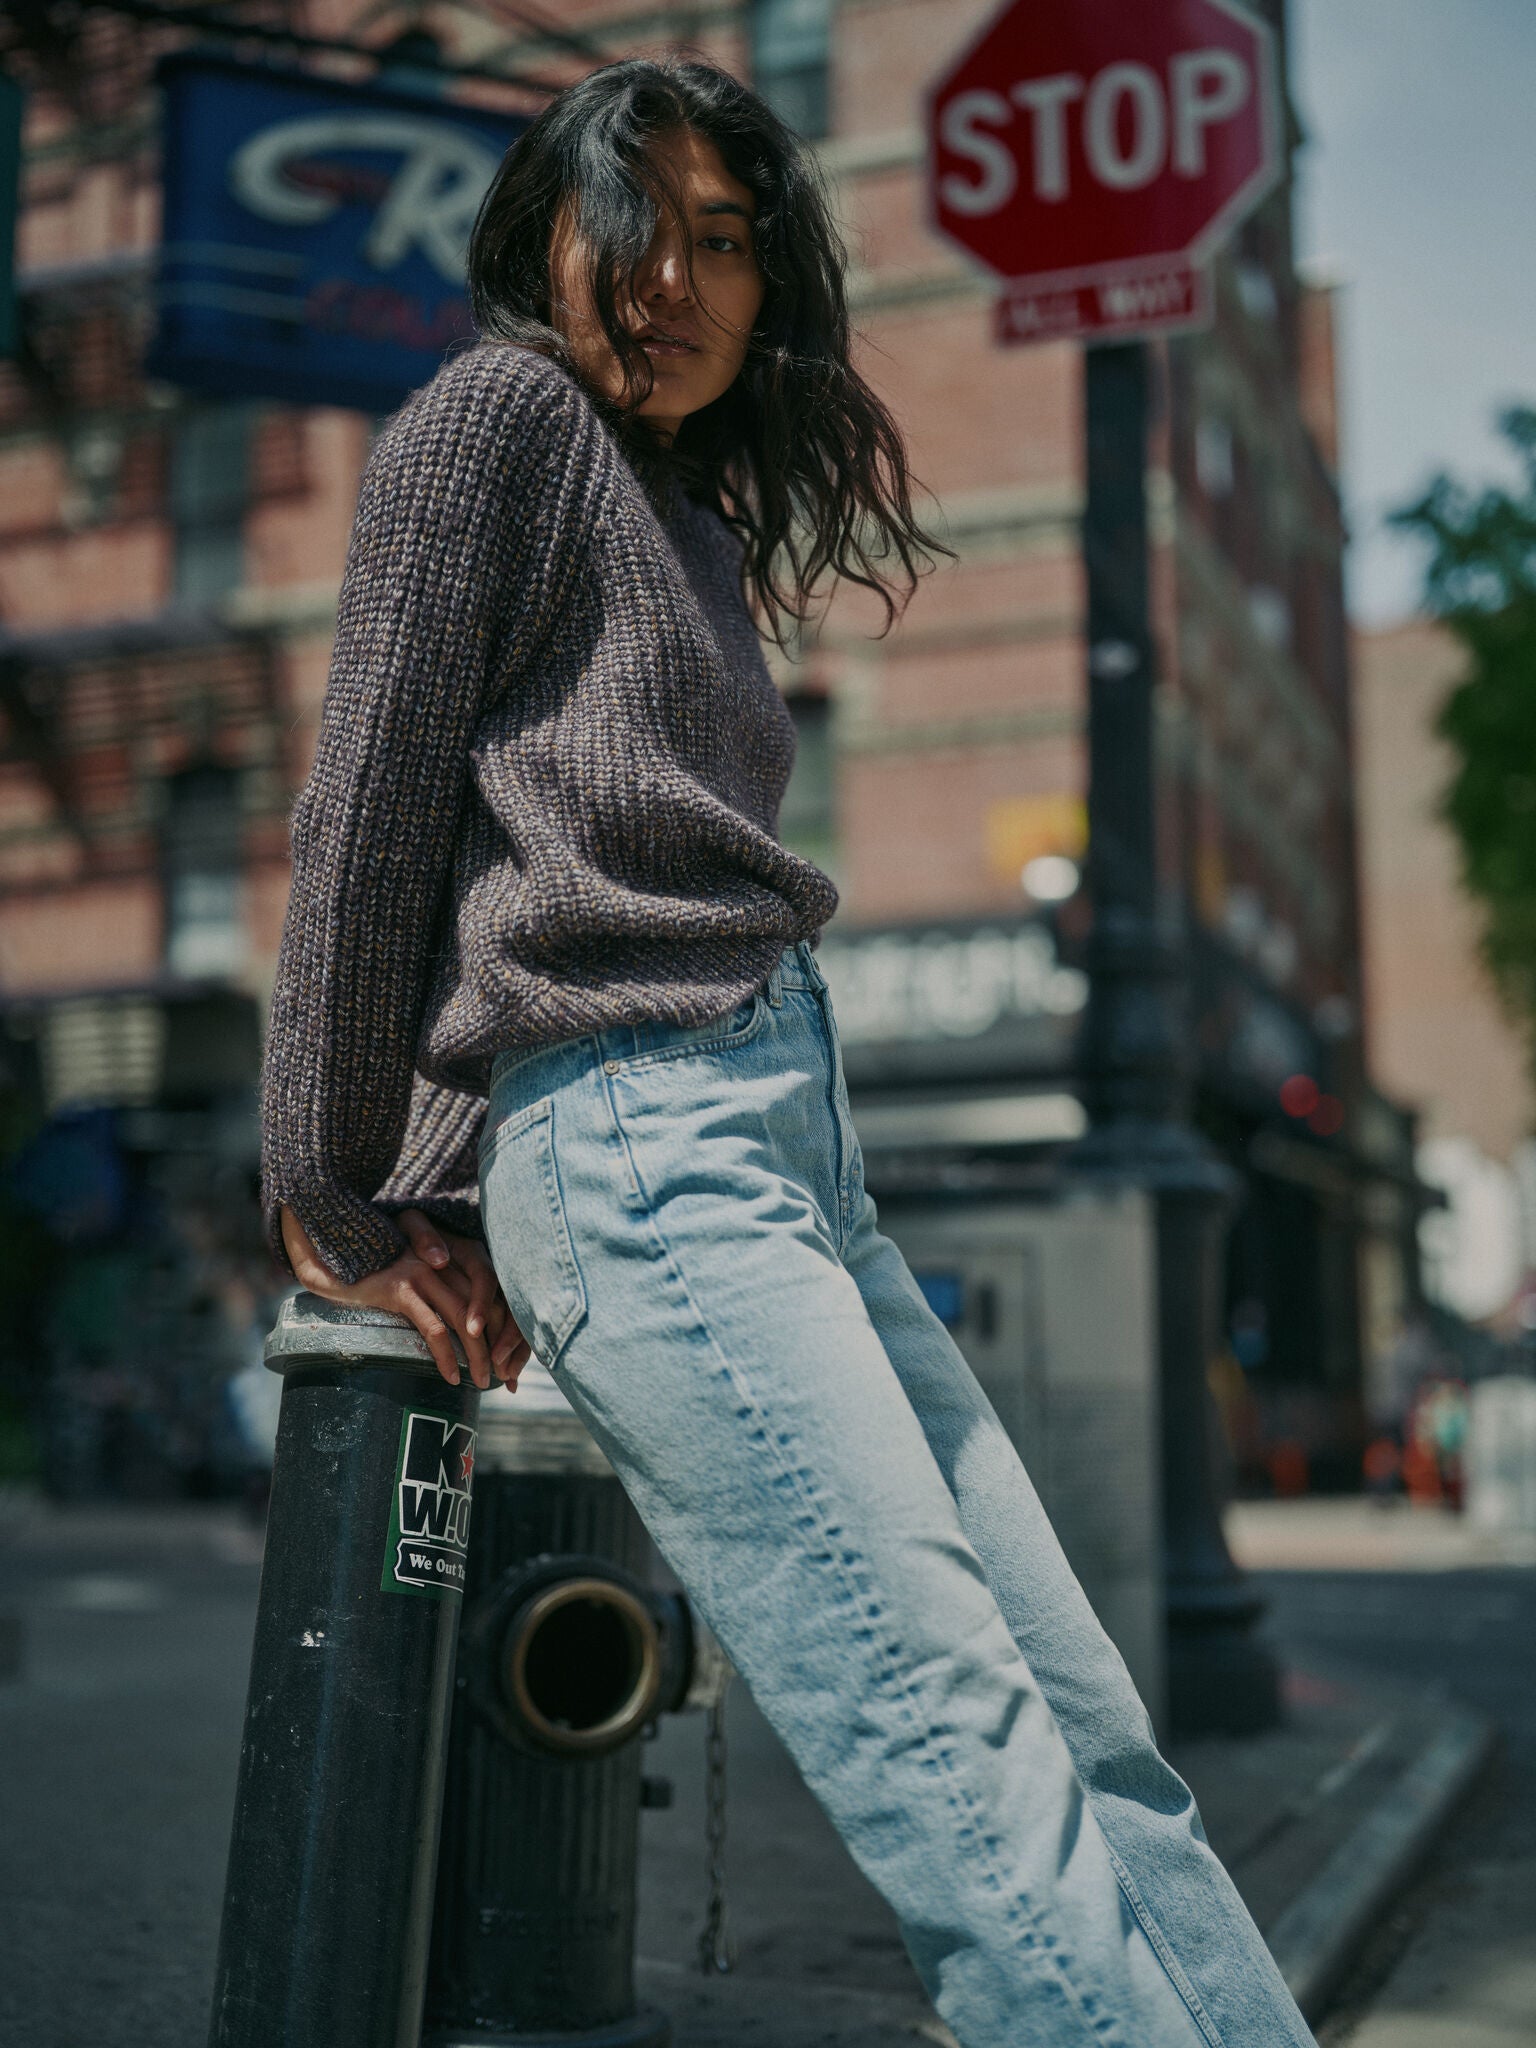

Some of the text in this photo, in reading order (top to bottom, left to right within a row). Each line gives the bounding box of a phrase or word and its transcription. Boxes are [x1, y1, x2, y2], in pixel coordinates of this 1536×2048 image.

[942, 48, 1248, 217] STOP
[409, 1553, 432, 1570] We
[436, 1558, 456, 1576] Out
